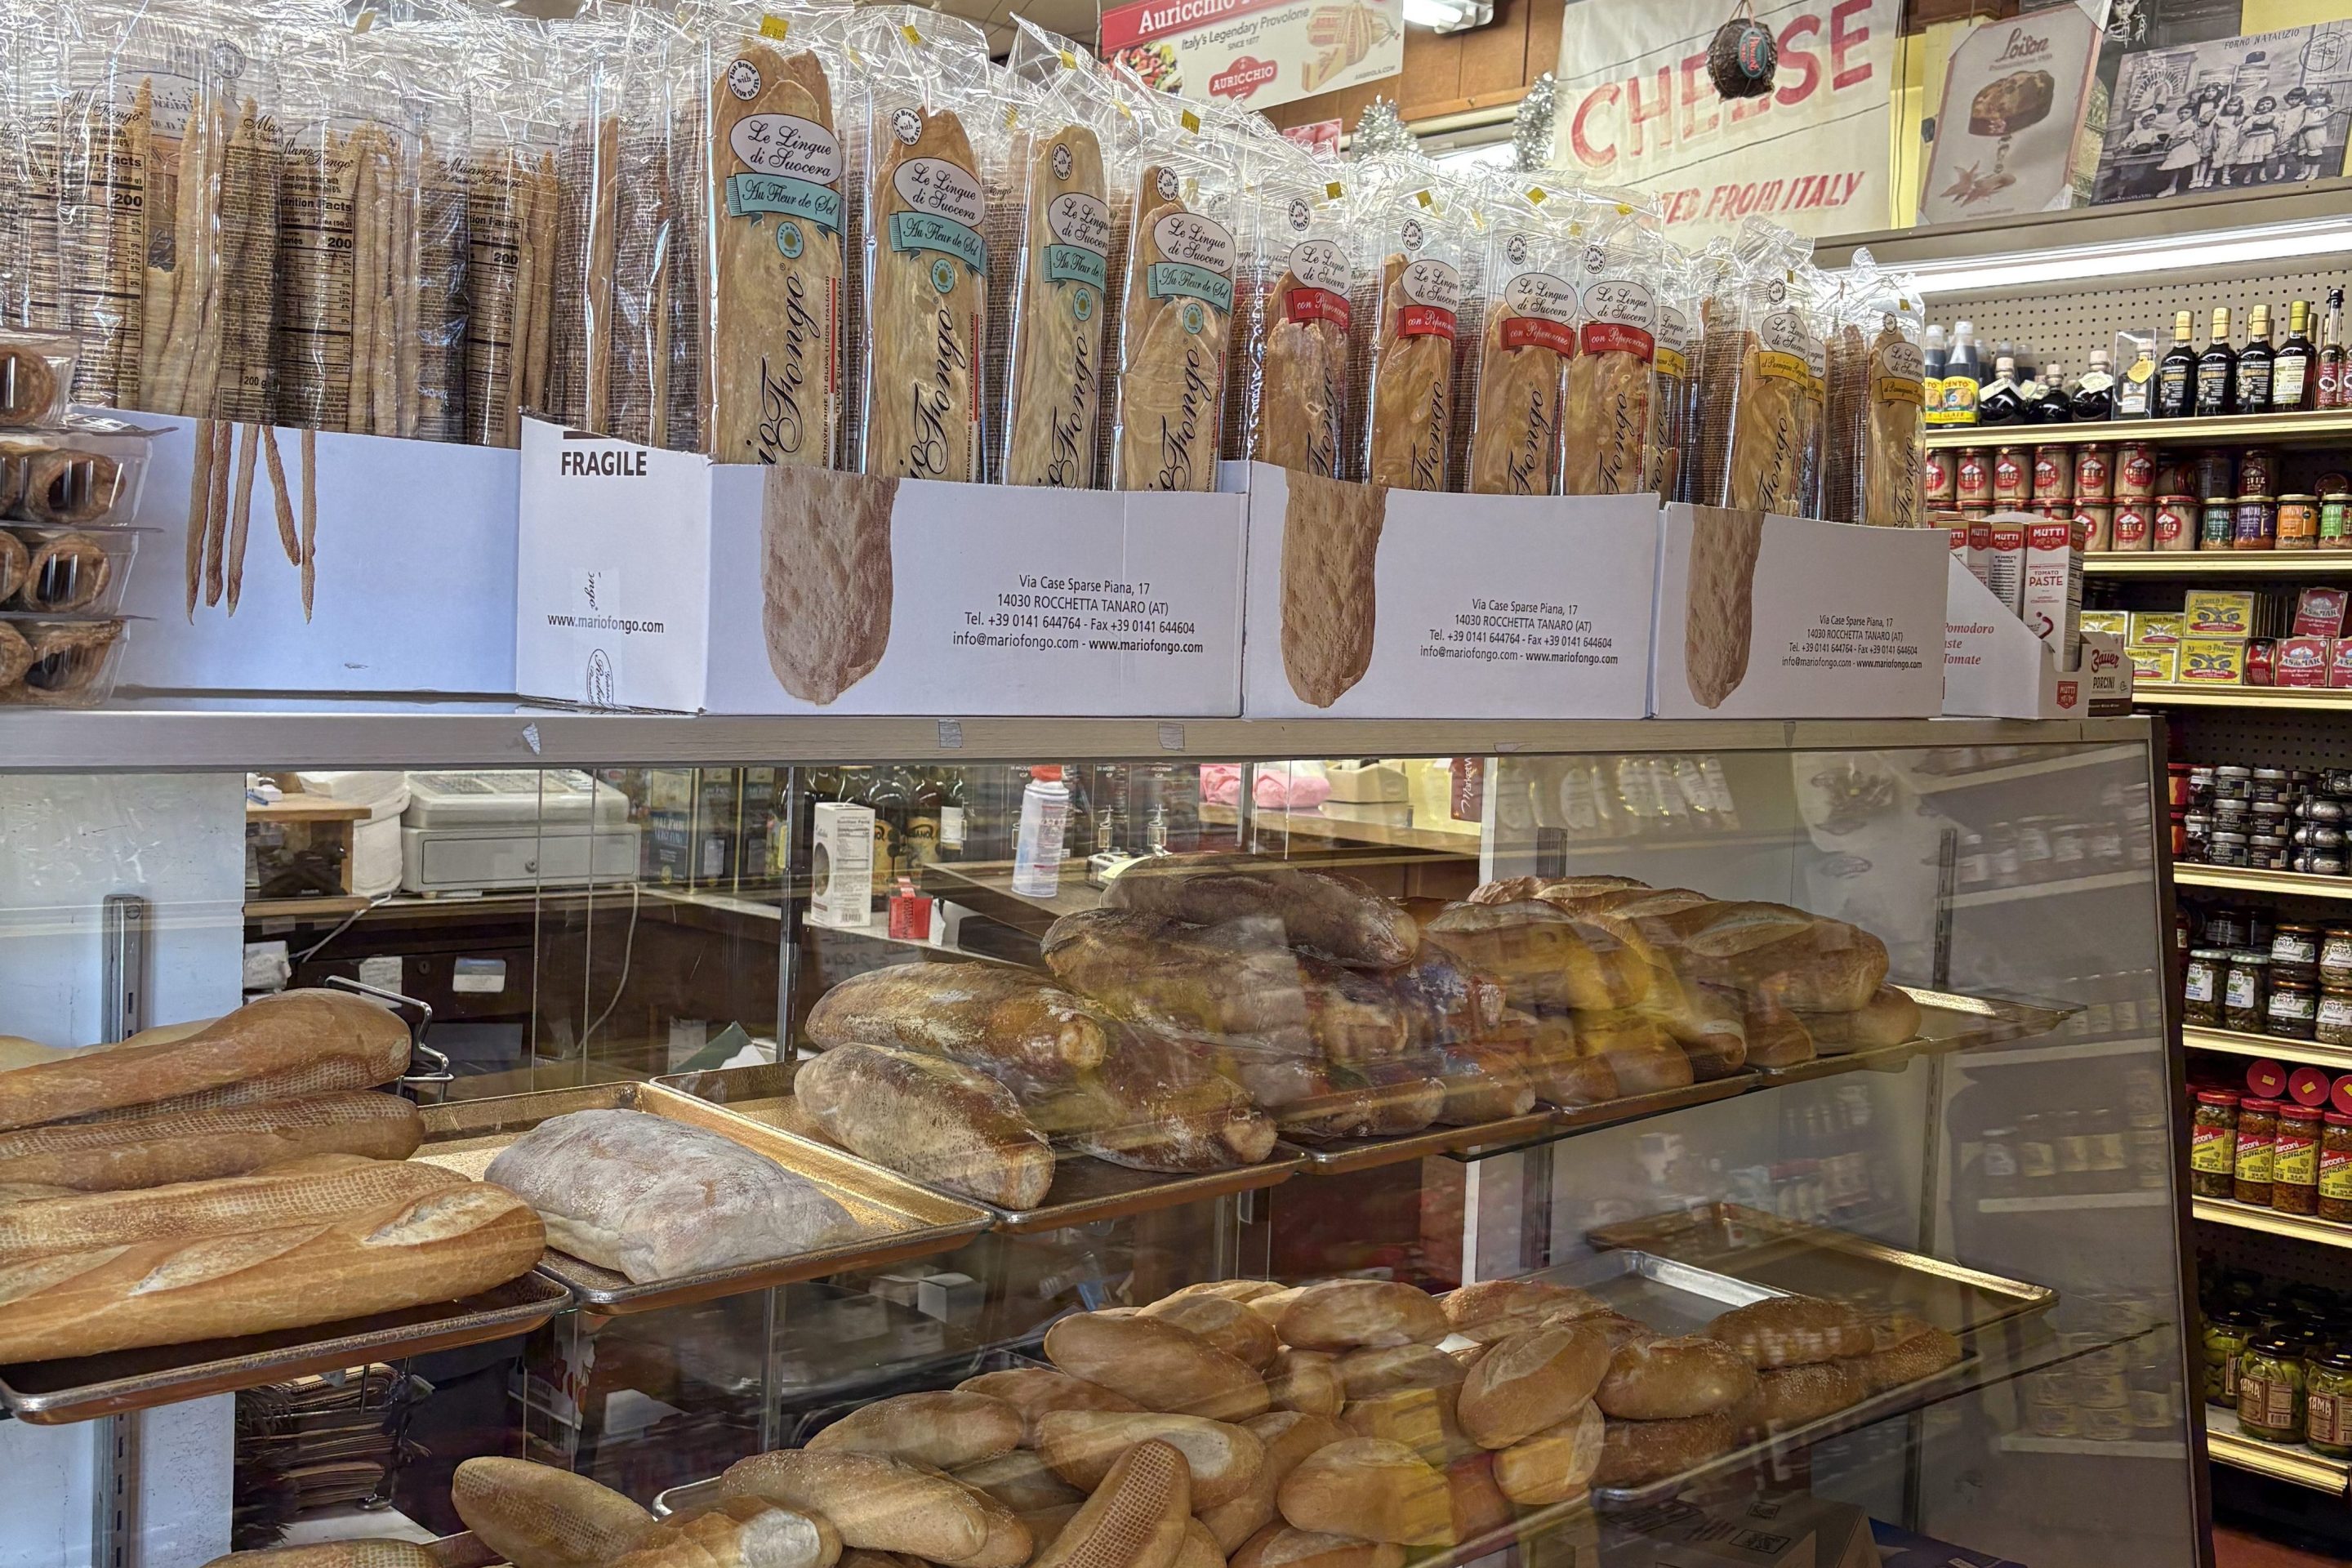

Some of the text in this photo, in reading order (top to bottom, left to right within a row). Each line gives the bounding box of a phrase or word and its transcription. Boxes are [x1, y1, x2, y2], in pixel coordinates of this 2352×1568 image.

[1182, 7, 1309, 51] Italy's Legendary Provolone
[1228, 39, 1244, 51] SINCE
[2224, 38, 2250, 50] FORNO
[737, 73, 751, 84] with
[1213, 67, 1274, 91] AURICCHIO
[732, 83, 746, 97] FLEUR
[748, 121, 831, 159] Le Lingue
[751, 147, 831, 176] di Suocera
[912, 163, 975, 202] Le Lingue
[114, 194, 143, 207] 200
[767, 182, 796, 203] Fleur
[799, 194, 811, 208] de
[815, 195, 837, 216] Sel
[913, 189, 975, 220] di Suocera
[1704, 171, 1864, 222] FROM ITALY
[1062, 198, 1108, 232] Le Lingu
[925, 221, 951, 242] Fleur
[952, 234, 961, 246] de
[964, 237, 979, 256] Sel
[1062, 222, 1071, 237] di
[1168, 218, 1225, 252] Le Lingue
[327, 237, 352, 249] 200
[494, 252, 518, 264] 200
[1168, 240, 1225, 266] di Suocera
[1302, 246, 1319, 263] Le
[1070, 255, 1090, 272] Fleur
[1091, 265, 1098, 276] de
[1303, 267, 1313, 280] di
[1414, 265, 1428, 282] Le
[1178, 270, 1201, 288] Fleur
[1201, 280, 1210, 292] de
[1213, 283, 1228, 298] Sel
[1415, 285, 1424, 298] di
[1518, 278, 1568, 304] Le Lingue
[1298, 299, 1312, 310] con
[1517, 297, 1567, 317] di Suocera
[1597, 287, 1647, 311] Le Lingue
[1408, 318, 1421, 327] con
[1597, 305, 1646, 323] di Suocera
[1511, 328, 1522, 336] con
[1772, 336, 1780, 345] di
[244, 376, 259, 385] 200
[561, 451, 647, 476] FRAGILE
[1971, 528, 1989, 537] MUTTI
[2034, 528, 2065, 537] MUTTI
[1020, 575, 1150, 595] Via Case Sparse Piana, 17
[2029, 576, 2063, 586] PASTE
[998, 594, 1169, 616] 14030 ROCCHETTA TANARO (AT)
[1472, 599, 1578, 615] Via Case Sparse Piana, 17
[548, 614, 664, 635] www.mariofongo.com
[965, 612, 1195, 634] Tel. +39 0141 644764 Fax +39 0141 644604
[1455, 614, 1592, 633] 14030 ROCCHETTA TANARO (AT)
[1820, 615, 1829, 625] Via
[1831, 616, 1845, 626] Case
[1846, 617, 1865, 627] Sparse
[1886, 618, 1893, 626] 17
[953, 631, 1203, 655] info@mariofongo.com www.mariofongo.com
[1430, 630, 1611, 648] Tel. +39 0141 644764 Fax +39 0141 644604
[1865, 630, 1890, 641] TANARO
[1420, 645, 1618, 666] info@mariofongo.com www.mariofongo.com
[1858, 644, 1868, 653] Fax
[2091, 648, 2119, 673] Bauer
[2093, 677, 2115, 688] PORCINI
